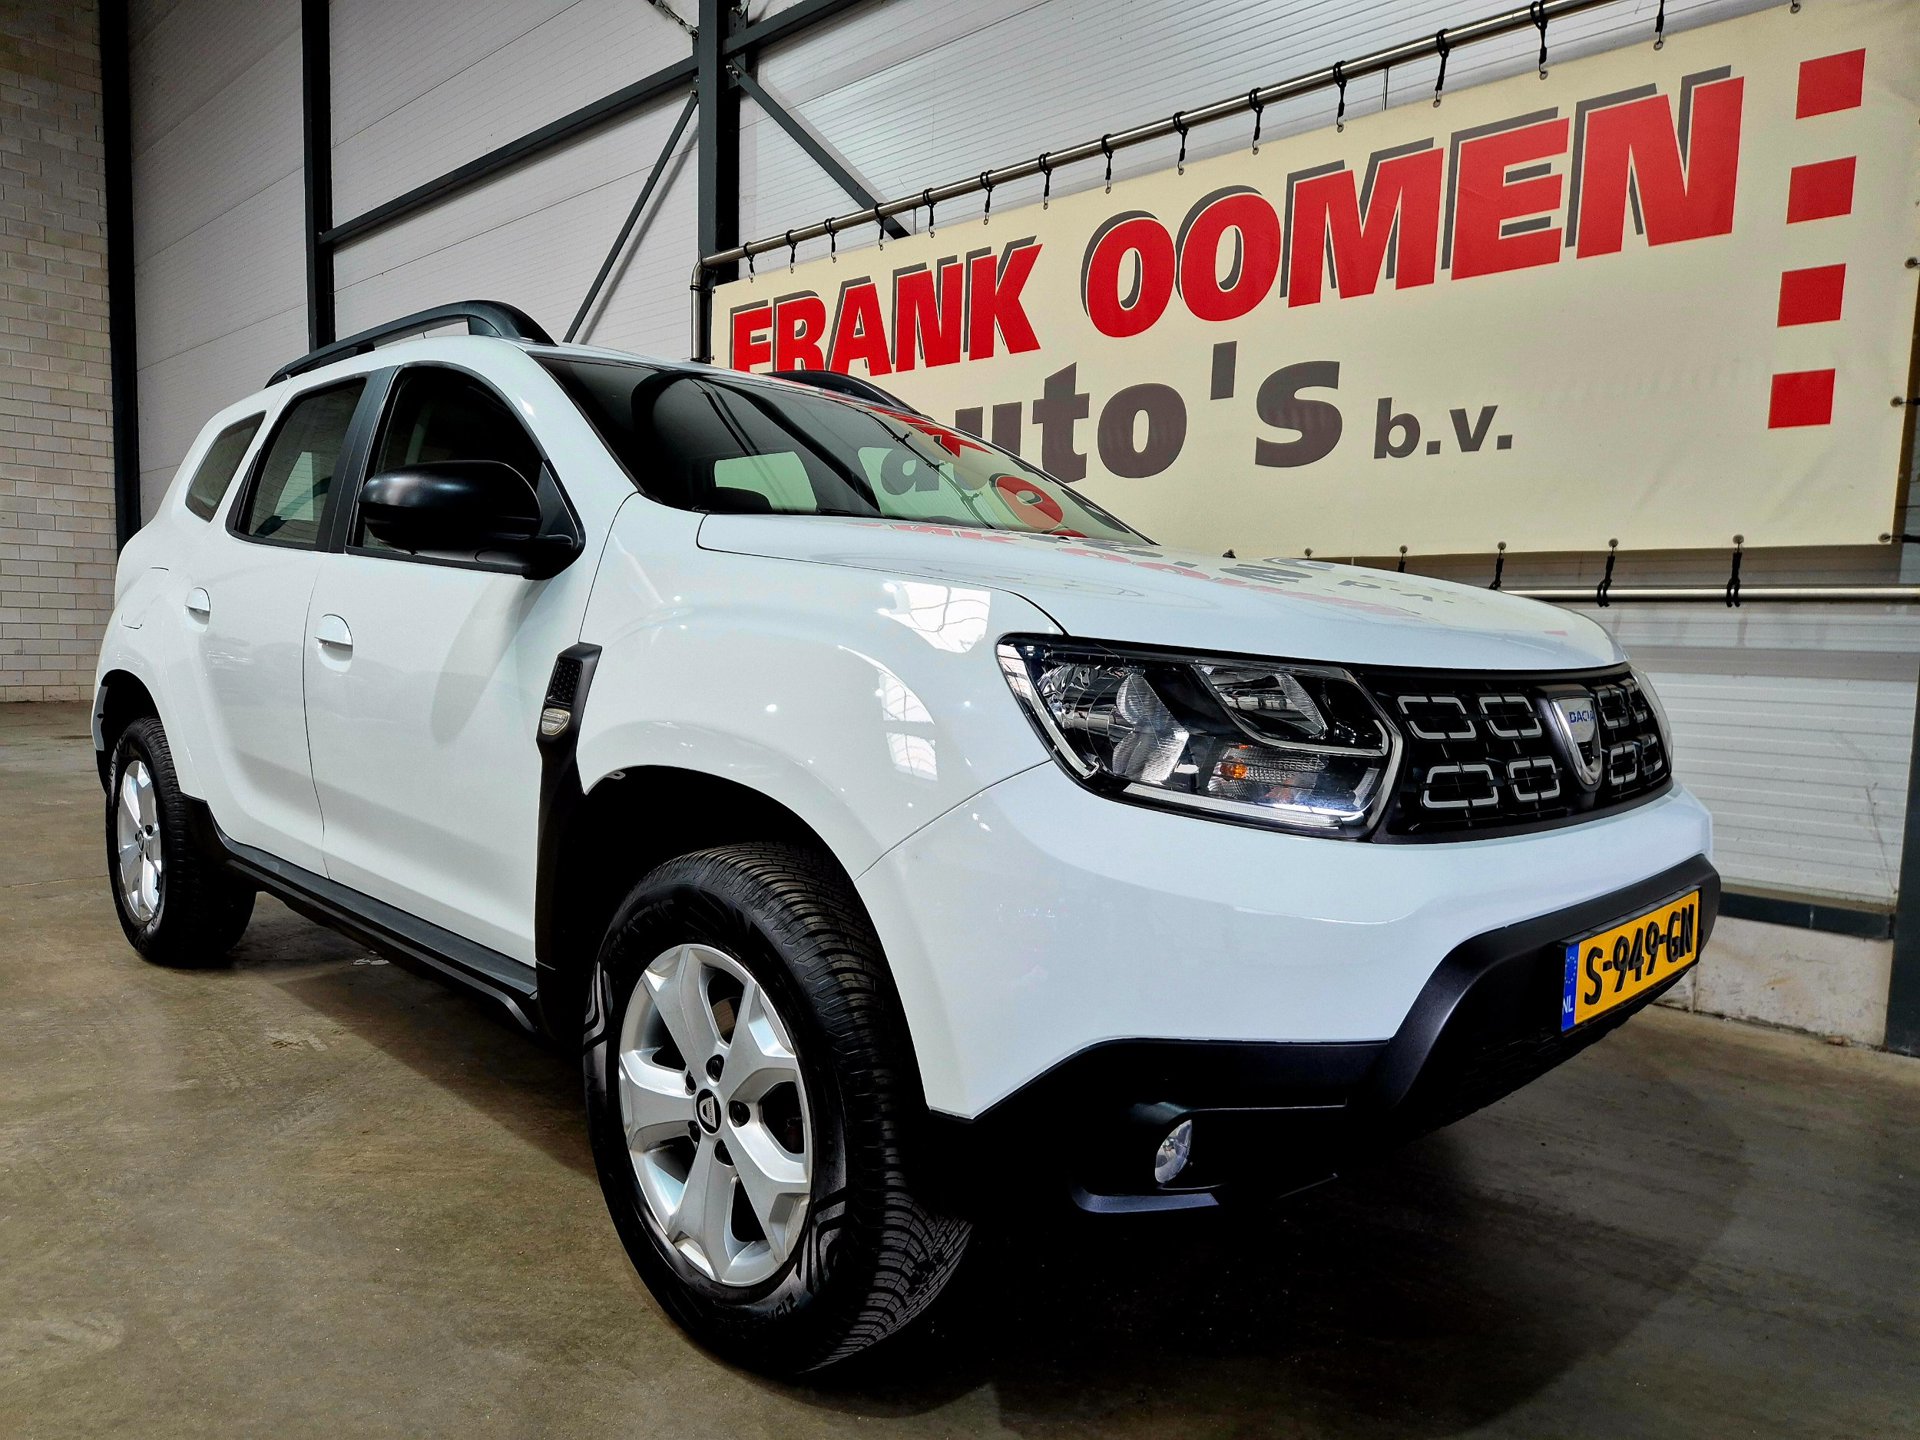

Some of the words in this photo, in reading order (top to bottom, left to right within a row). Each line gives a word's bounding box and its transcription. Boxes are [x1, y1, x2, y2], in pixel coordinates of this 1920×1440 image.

[730, 235, 1043, 376] FRANK
[1081, 65, 1745, 338] OOMEN
[1373, 397, 1514, 460] b.v.
[1568, 710, 1596, 723] DACIA
[1584, 903, 1695, 1005] S-949-GN
[1562, 995, 1574, 1015] NL
